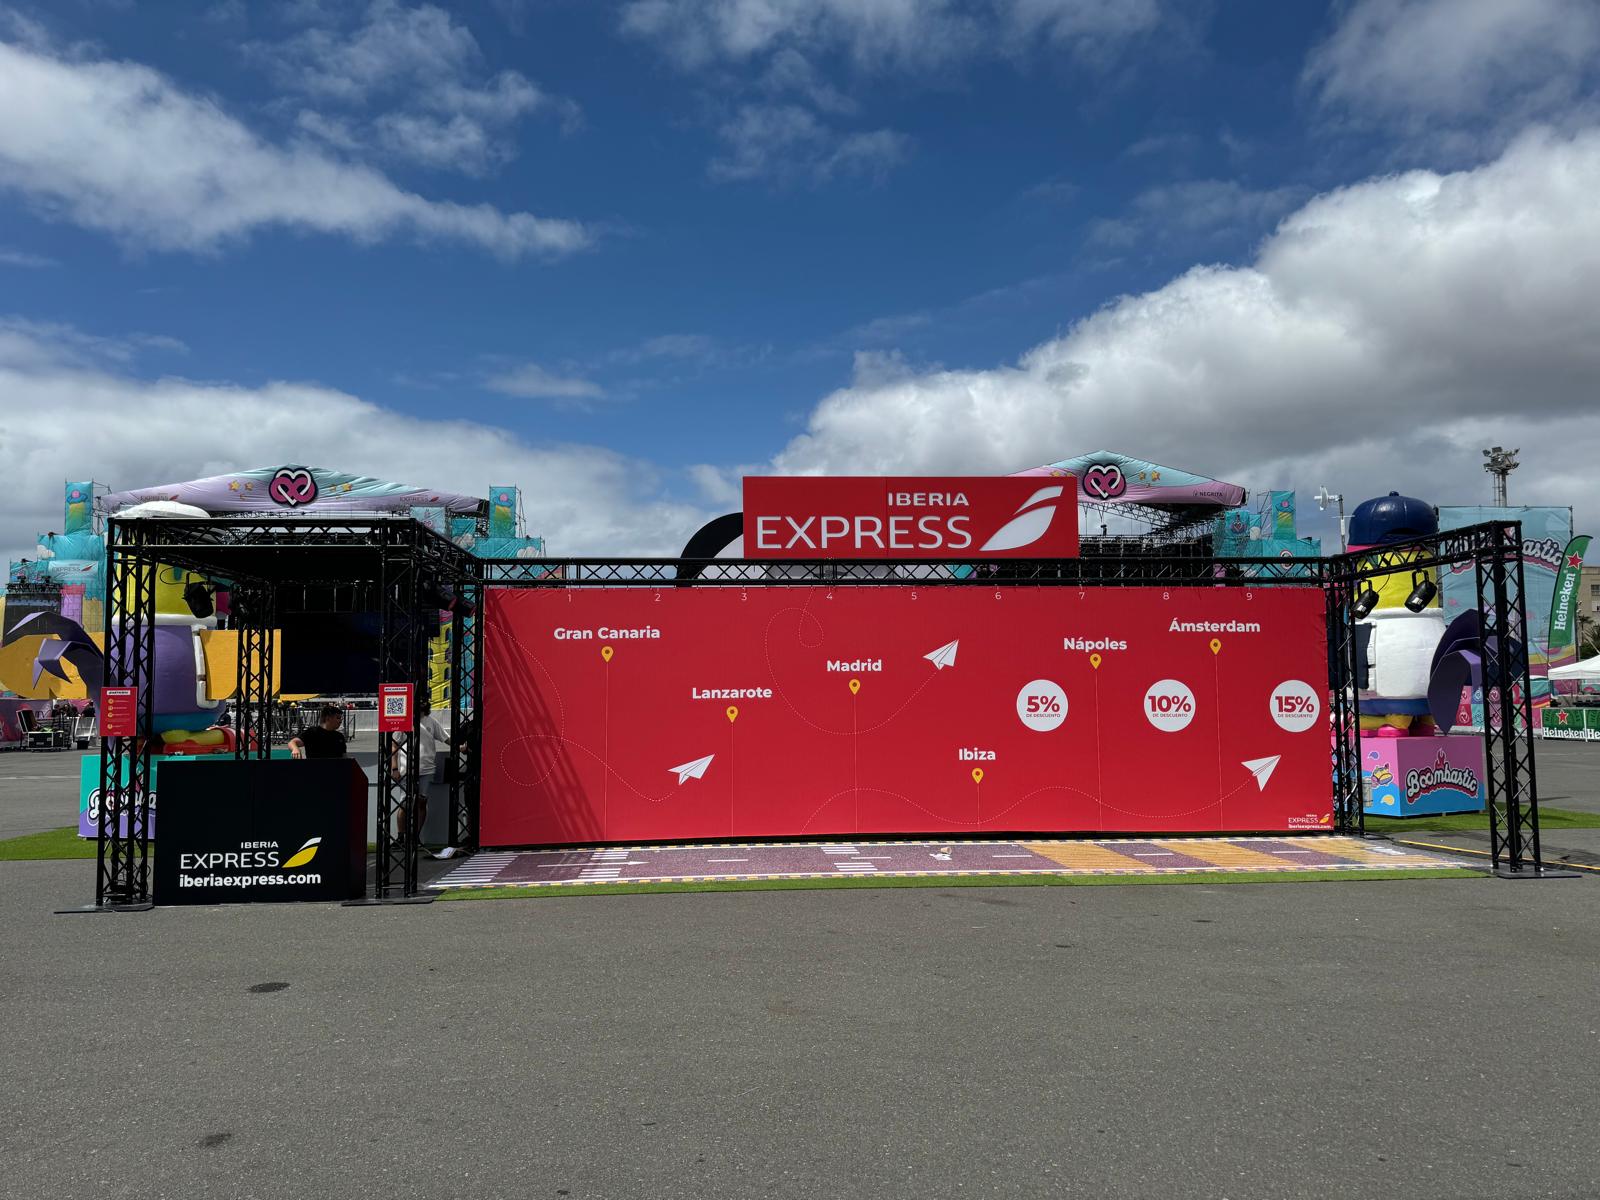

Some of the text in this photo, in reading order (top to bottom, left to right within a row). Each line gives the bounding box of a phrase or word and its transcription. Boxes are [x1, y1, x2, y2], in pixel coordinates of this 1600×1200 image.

[888, 492, 970, 507] IBERIA
[756, 515, 972, 549] EXPRESS
[567, 593, 572, 603] 1
[655, 593, 662, 602] 2
[741, 593, 748, 602] 3
[826, 592, 833, 601] 4
[911, 591, 918, 601] 5
[994, 591, 1002, 600] 6
[1078, 591, 1086, 600] 7
[1163, 591, 1170, 601] 8
[1246, 592, 1253, 601] 9
[1554, 573, 1576, 631] Heineken
[1168, 617, 1261, 633] Ámsterdam
[553, 625, 661, 640] Gran Canaria
[1063, 637, 1128, 654] Nápoles
[826, 658, 882, 672] Madrid
[692, 687, 773, 700] Lanzarote
[1026, 695, 1060, 713] 5%
[1148, 695, 1192, 713] 10%
[1275, 695, 1315, 713] 15%
[1543, 727, 1585, 739] Heineken
[958, 746, 997, 761] Ibiza
[1406, 762, 1477, 797] Boombastic
[240, 841, 279, 849] IBERIA
[180, 851, 280, 870] EXPRESS
[179, 873, 322, 889] iberiaexpress.com
